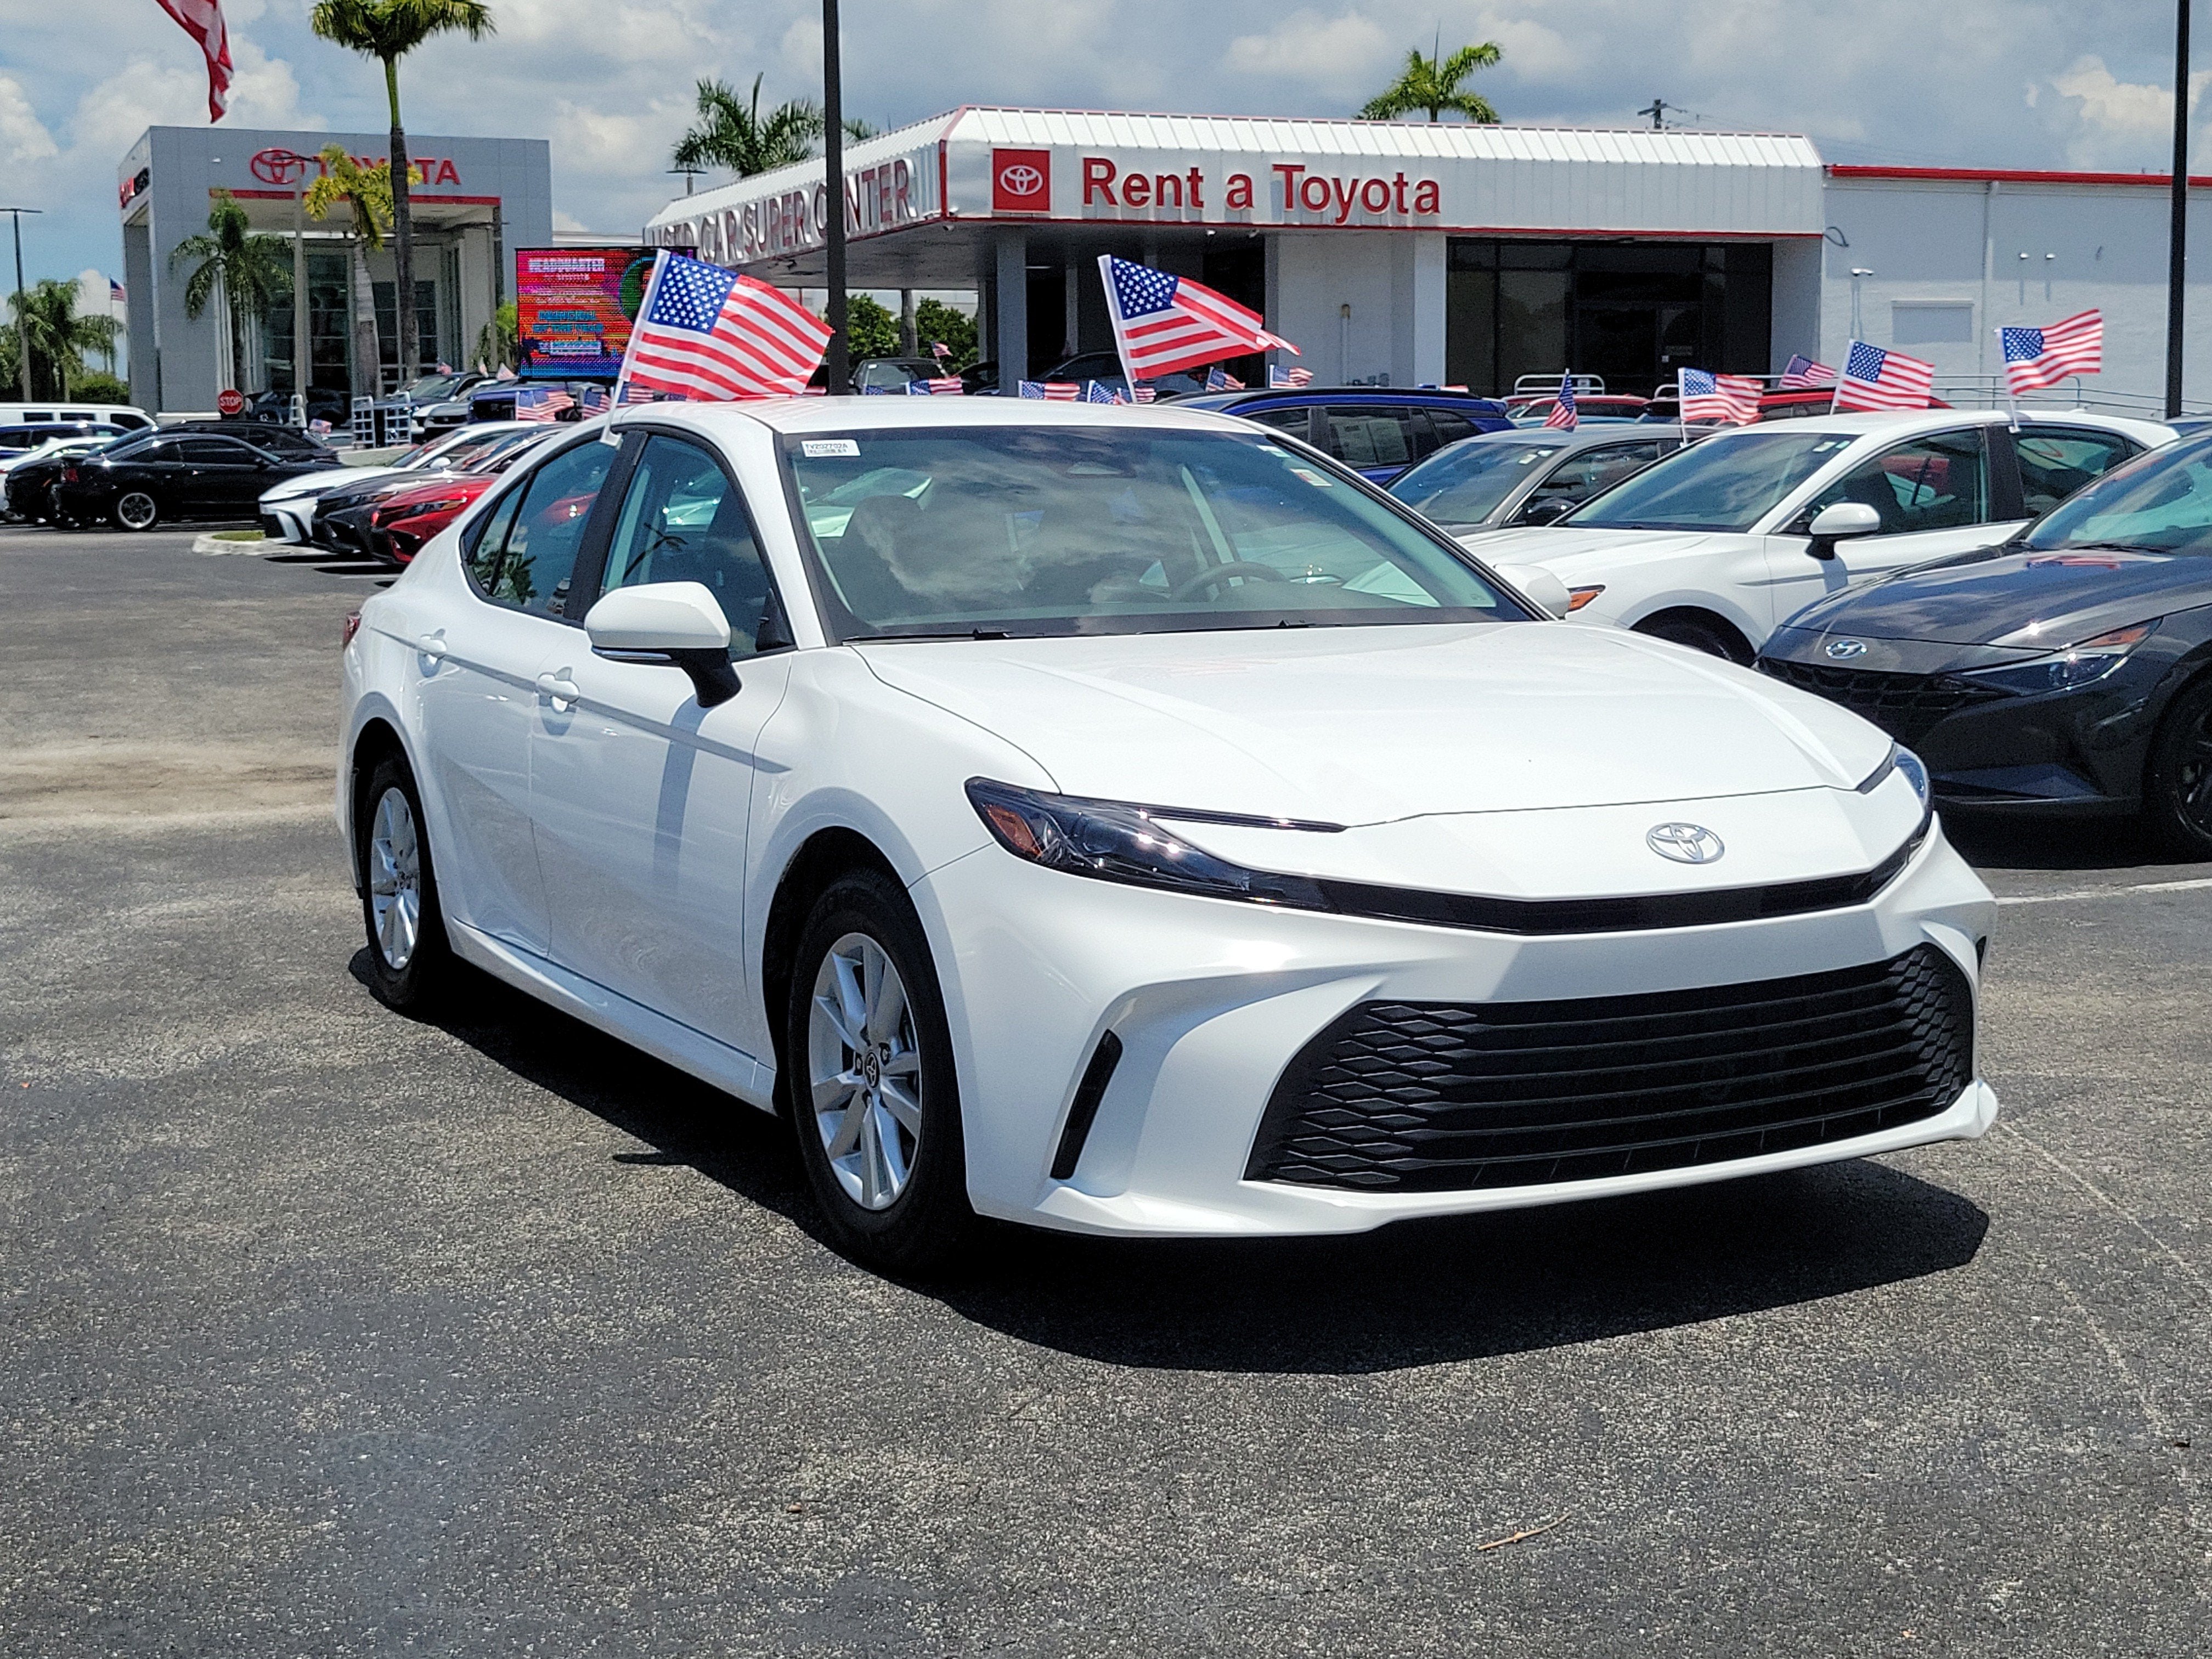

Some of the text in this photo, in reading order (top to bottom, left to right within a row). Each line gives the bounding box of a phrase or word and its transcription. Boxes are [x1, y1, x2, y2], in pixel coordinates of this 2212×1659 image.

[814, 157, 918, 240] CNTER
[1083, 157, 1441, 225] Rent a Toyota
[220, 396, 242, 407] STOP
